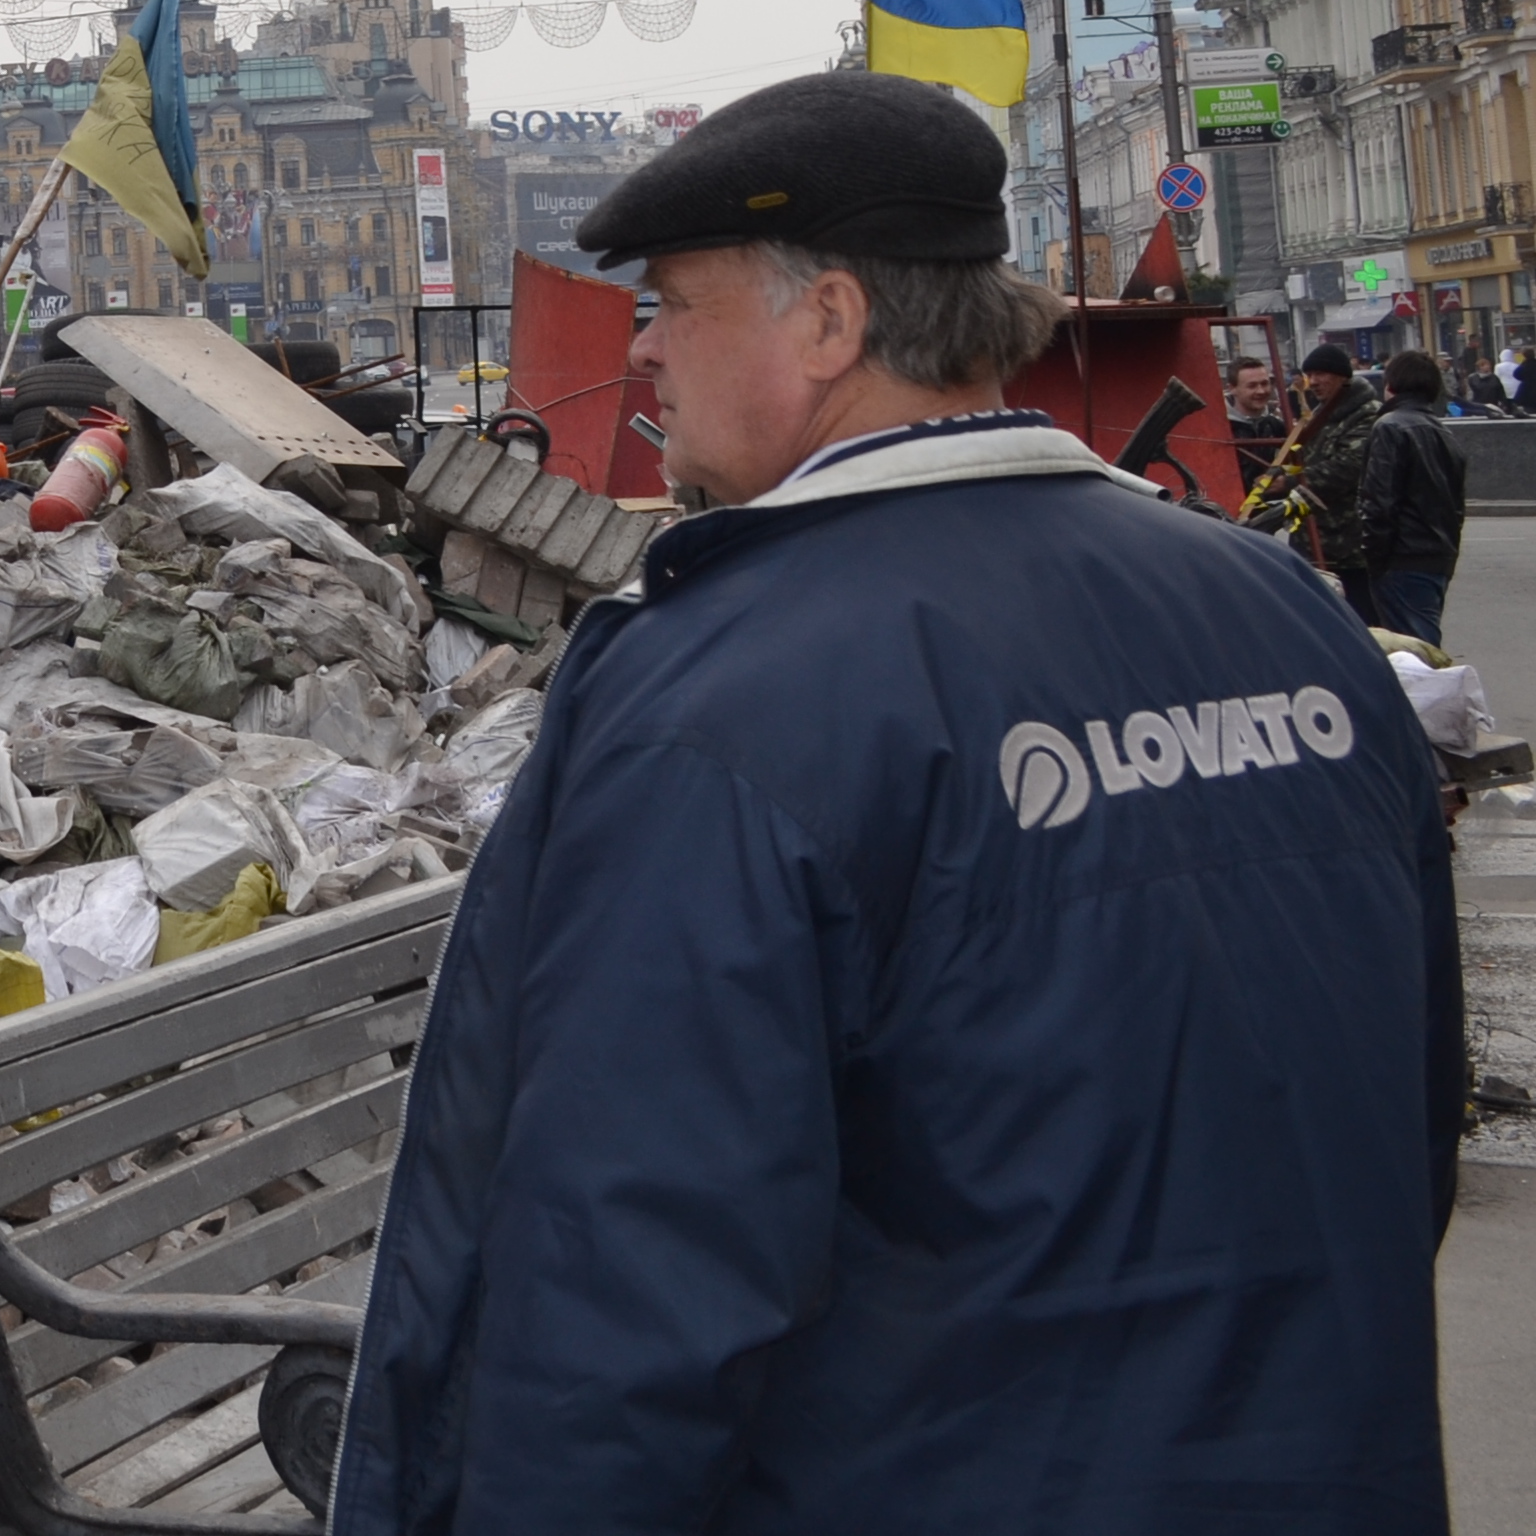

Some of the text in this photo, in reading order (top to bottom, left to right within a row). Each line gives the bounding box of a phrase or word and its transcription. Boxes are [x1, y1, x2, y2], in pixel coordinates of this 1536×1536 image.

[1219, 88, 1253, 100] ВАША
[1210, 100, 1264, 113] РЕКЛАМА
[490, 110, 622, 142] SONY
[1198, 116, 1212, 124] НА
[1214, 125, 1262, 136] 423-0-424
[533, 192, 598, 214] Шукаєш
[1084, 685, 1354, 795] LOVATO
